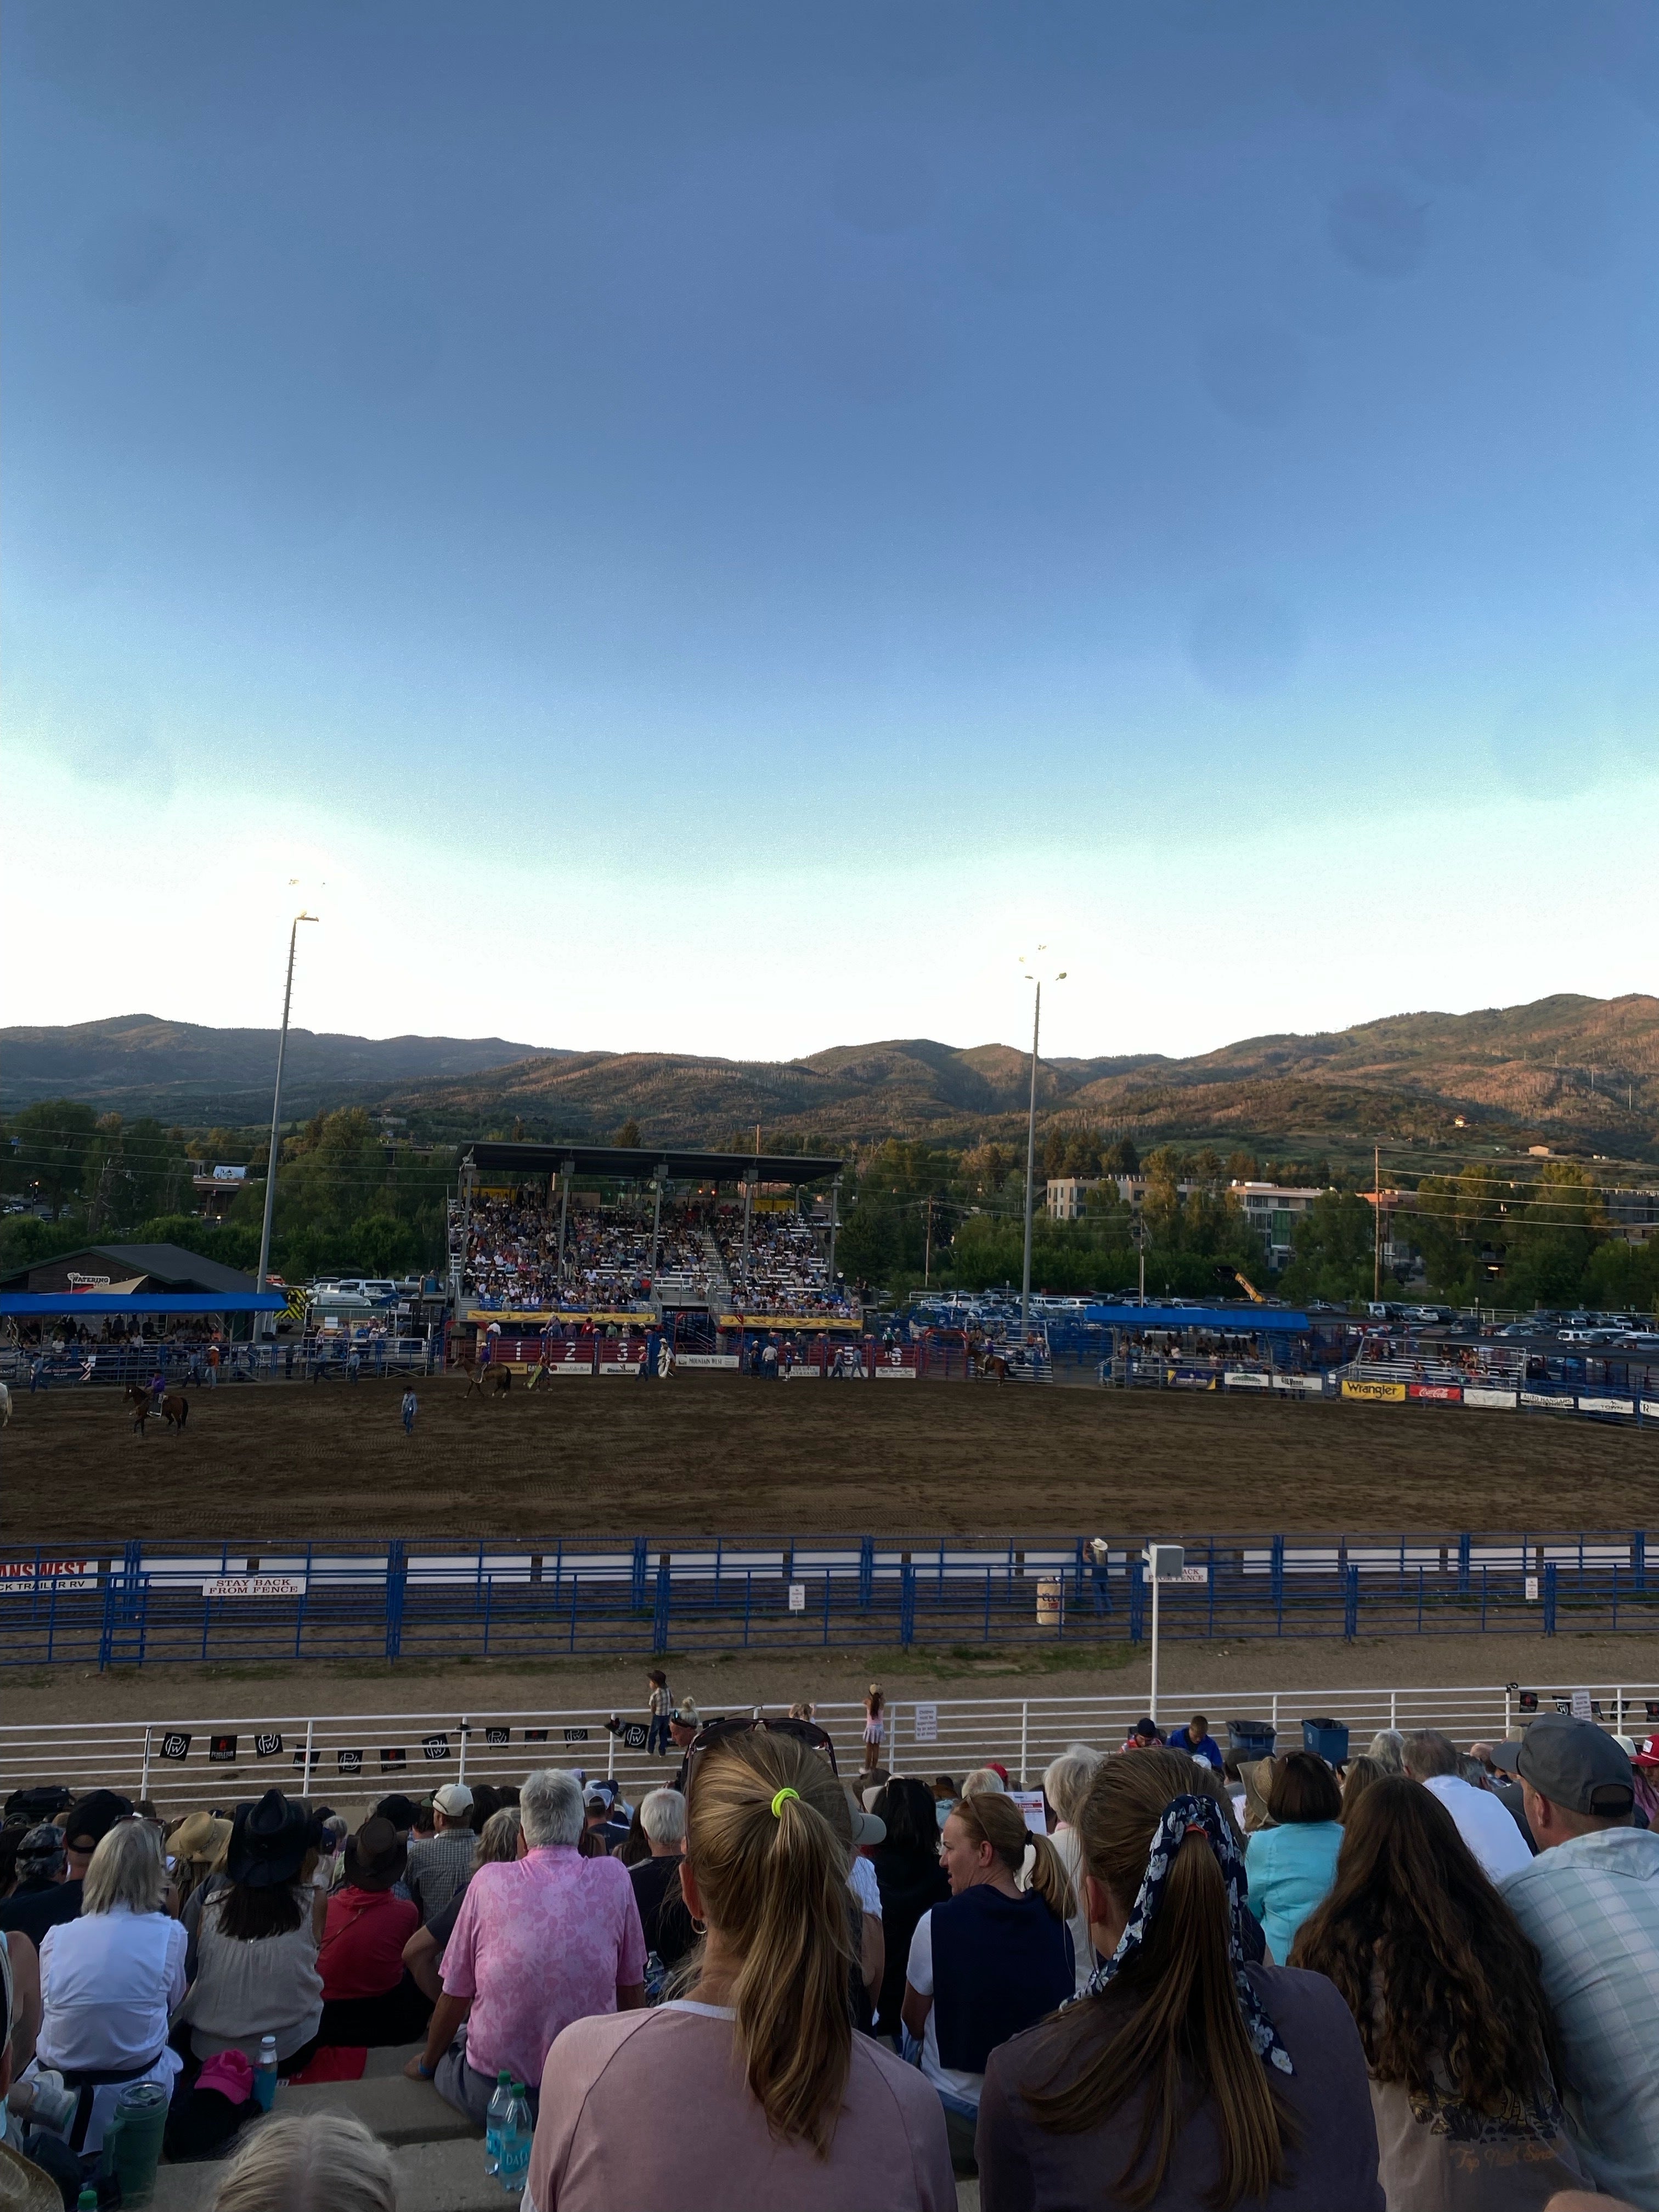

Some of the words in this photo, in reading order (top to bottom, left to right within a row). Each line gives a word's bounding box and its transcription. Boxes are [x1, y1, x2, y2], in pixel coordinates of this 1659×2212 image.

[515, 1341, 522, 1361] 1
[565, 1341, 576, 1361] 2
[617, 1342, 628, 1361] 3
[844, 1346, 854, 1364] 5
[891, 1347, 902, 1365] 6
[1347, 1382, 1398, 1399] Wrangler
[40, 1562, 87, 1576] WEST
